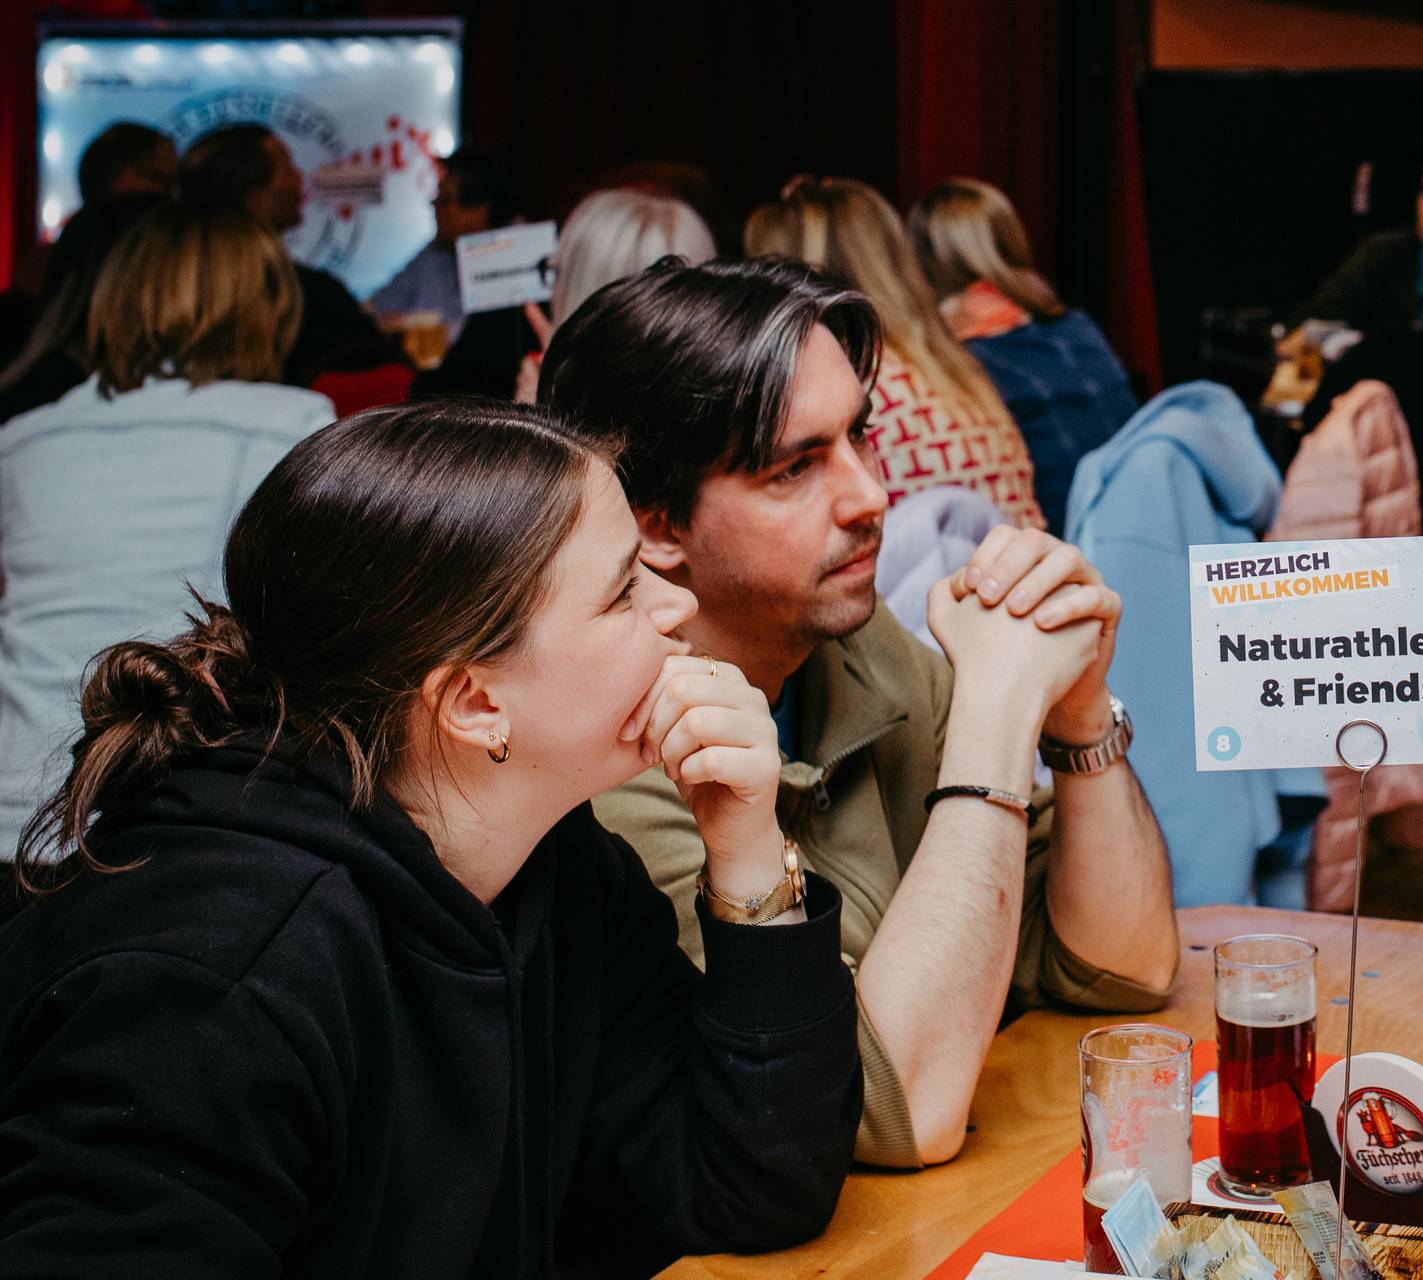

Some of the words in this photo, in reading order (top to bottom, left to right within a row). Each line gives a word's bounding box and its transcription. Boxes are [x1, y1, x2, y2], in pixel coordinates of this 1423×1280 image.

[1206, 551, 1330, 582] HERZLICH
[1211, 568, 1389, 605] WILLKOMMEN
[1260, 678, 1285, 708] &
[1215, 734, 1232, 753] 8
[1383, 1174, 1401, 1186] seit
